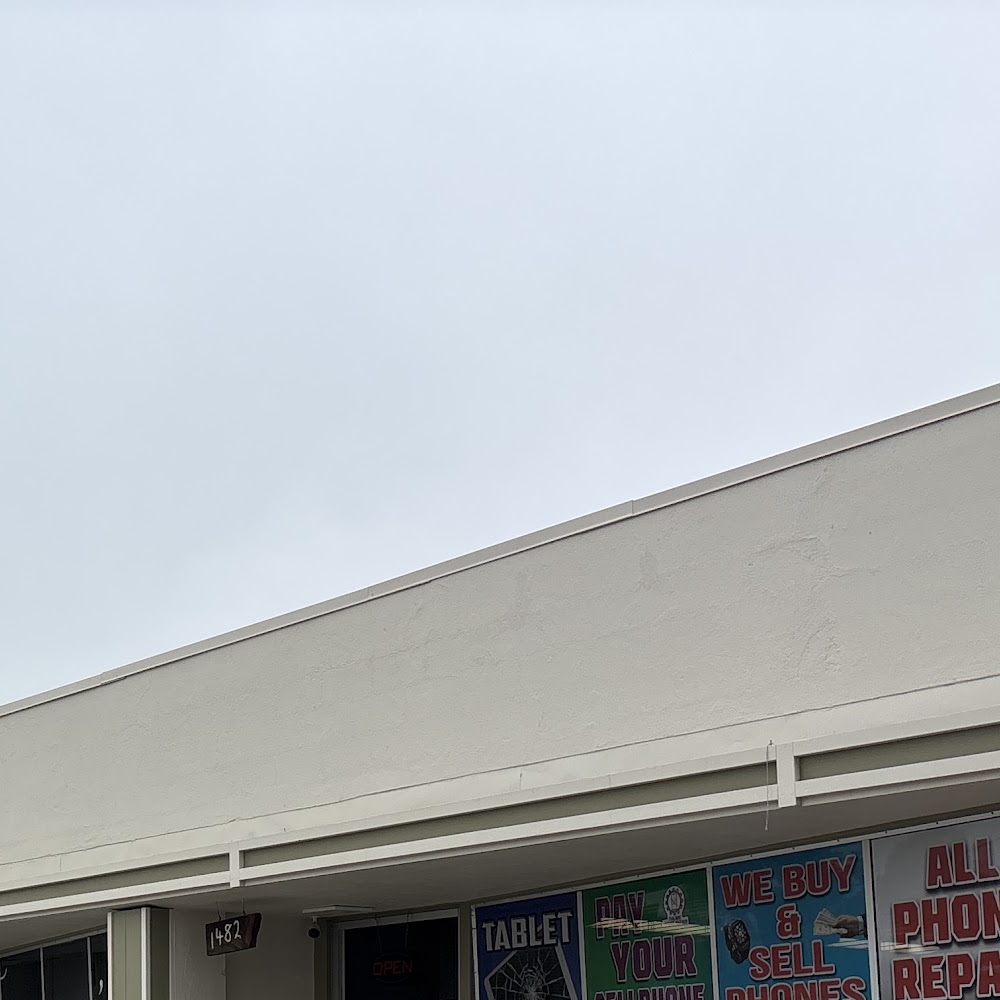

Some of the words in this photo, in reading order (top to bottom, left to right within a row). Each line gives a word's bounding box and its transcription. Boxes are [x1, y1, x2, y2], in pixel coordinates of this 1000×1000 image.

[720, 868, 775, 908] WE
[782, 854, 857, 900] BUY
[926, 836, 1000, 890] ALL
[211, 920, 242, 950] 1482
[481, 911, 573, 951] TABLET
[595, 890, 645, 939] PAY
[776, 903, 801, 939] &
[372, 960, 413, 976] OPEN
[610, 934, 698, 983] YOUR
[749, 939, 836, 981] SELL
